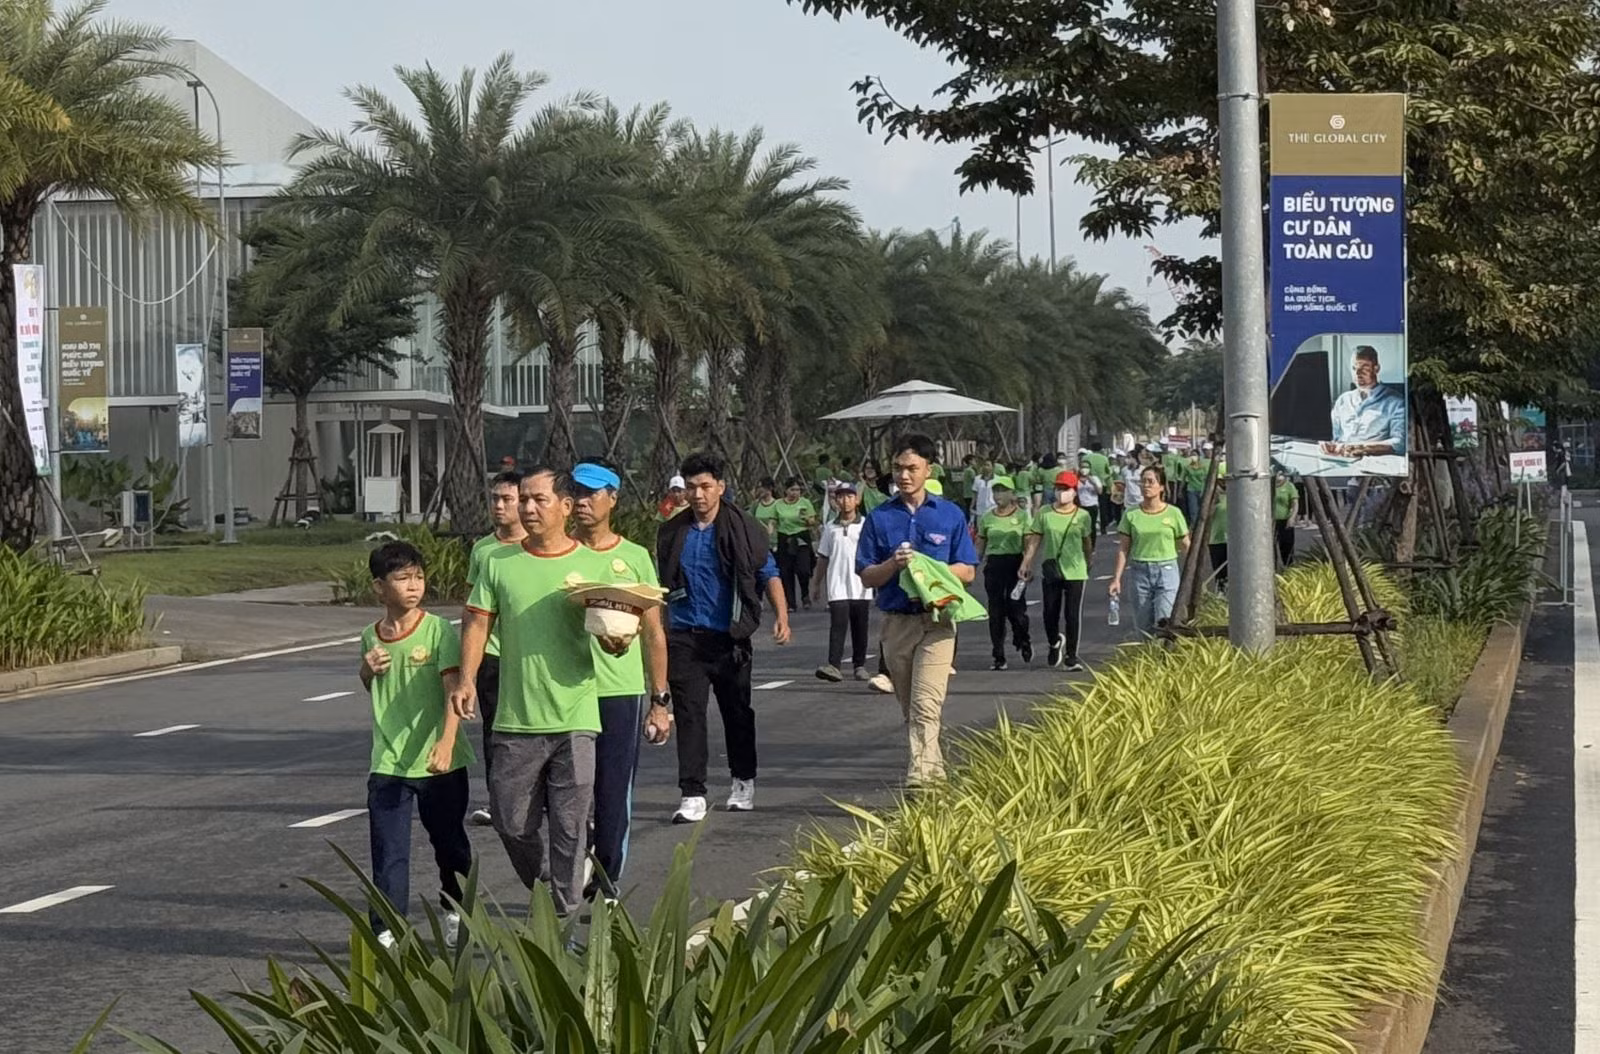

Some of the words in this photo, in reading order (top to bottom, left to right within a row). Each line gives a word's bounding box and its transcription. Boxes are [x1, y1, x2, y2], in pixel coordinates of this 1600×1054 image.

[1288, 133, 1310, 144] THE
[1313, 133, 1359, 144] GLOBAL
[1361, 133, 1387, 144] CITY
[1283, 190, 1326, 212] BIỂU
[1329, 196, 1395, 217] TƯỢNG
[1283, 219, 1311, 236] CƯ
[1313, 216, 1352, 236] DÂN
[1283, 239, 1332, 259] TOÀN
[1335, 238, 1373, 259] CẦU
[1296, 294, 1317, 303] QUỐC
[1325, 303, 1346, 312] QUỐC
